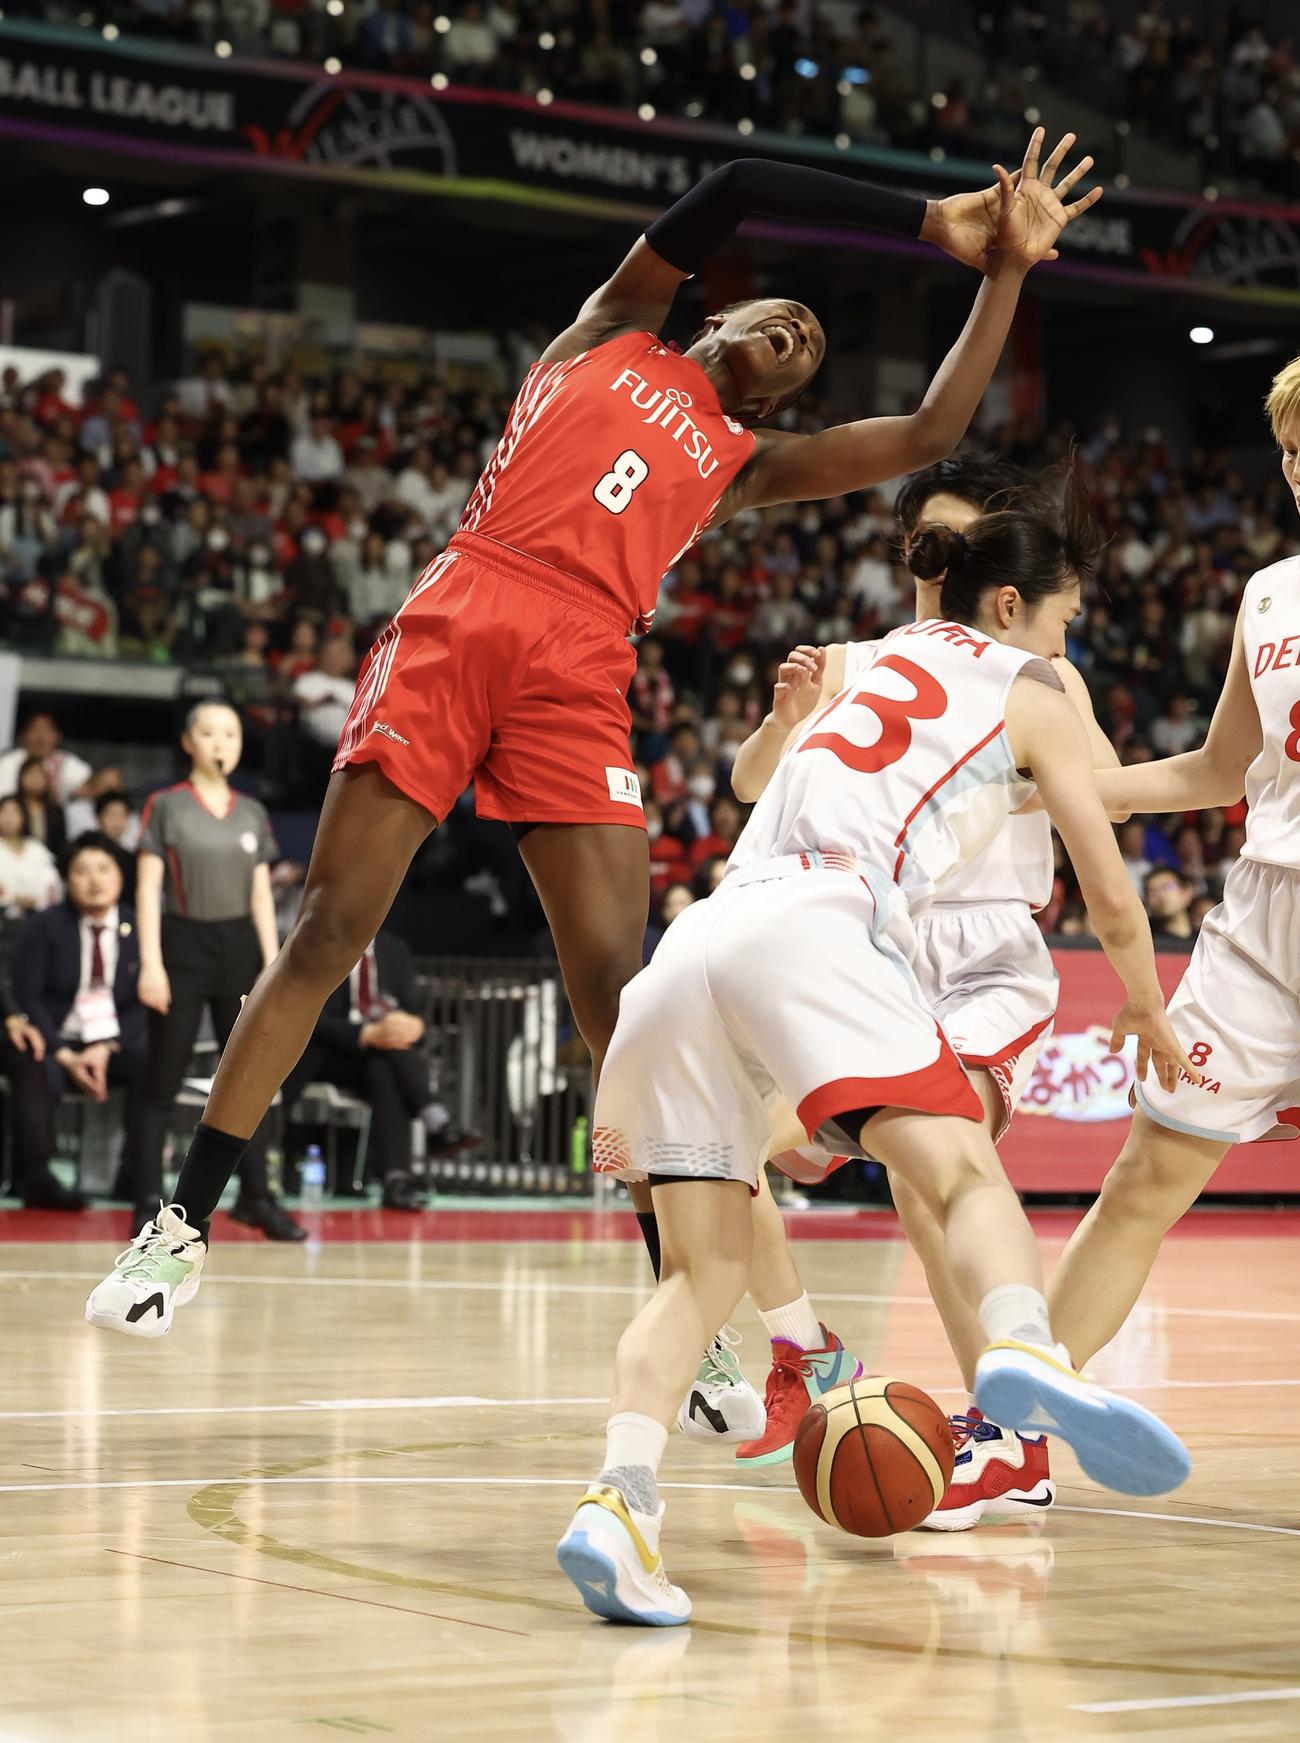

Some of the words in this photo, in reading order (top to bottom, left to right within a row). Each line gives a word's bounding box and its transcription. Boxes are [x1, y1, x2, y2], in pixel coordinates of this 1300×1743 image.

[90, 70, 235, 132] LEAGUE
[509, 128, 692, 194] WOMEN'S
[1060, 212, 1132, 256] GUE
[609, 368, 720, 479] FUJITSU
[592, 448, 650, 515] 8
[1253, 634, 1300, 680] DE
[796, 653, 948, 775] 3
[1187, 1041, 1213, 1067] 8
